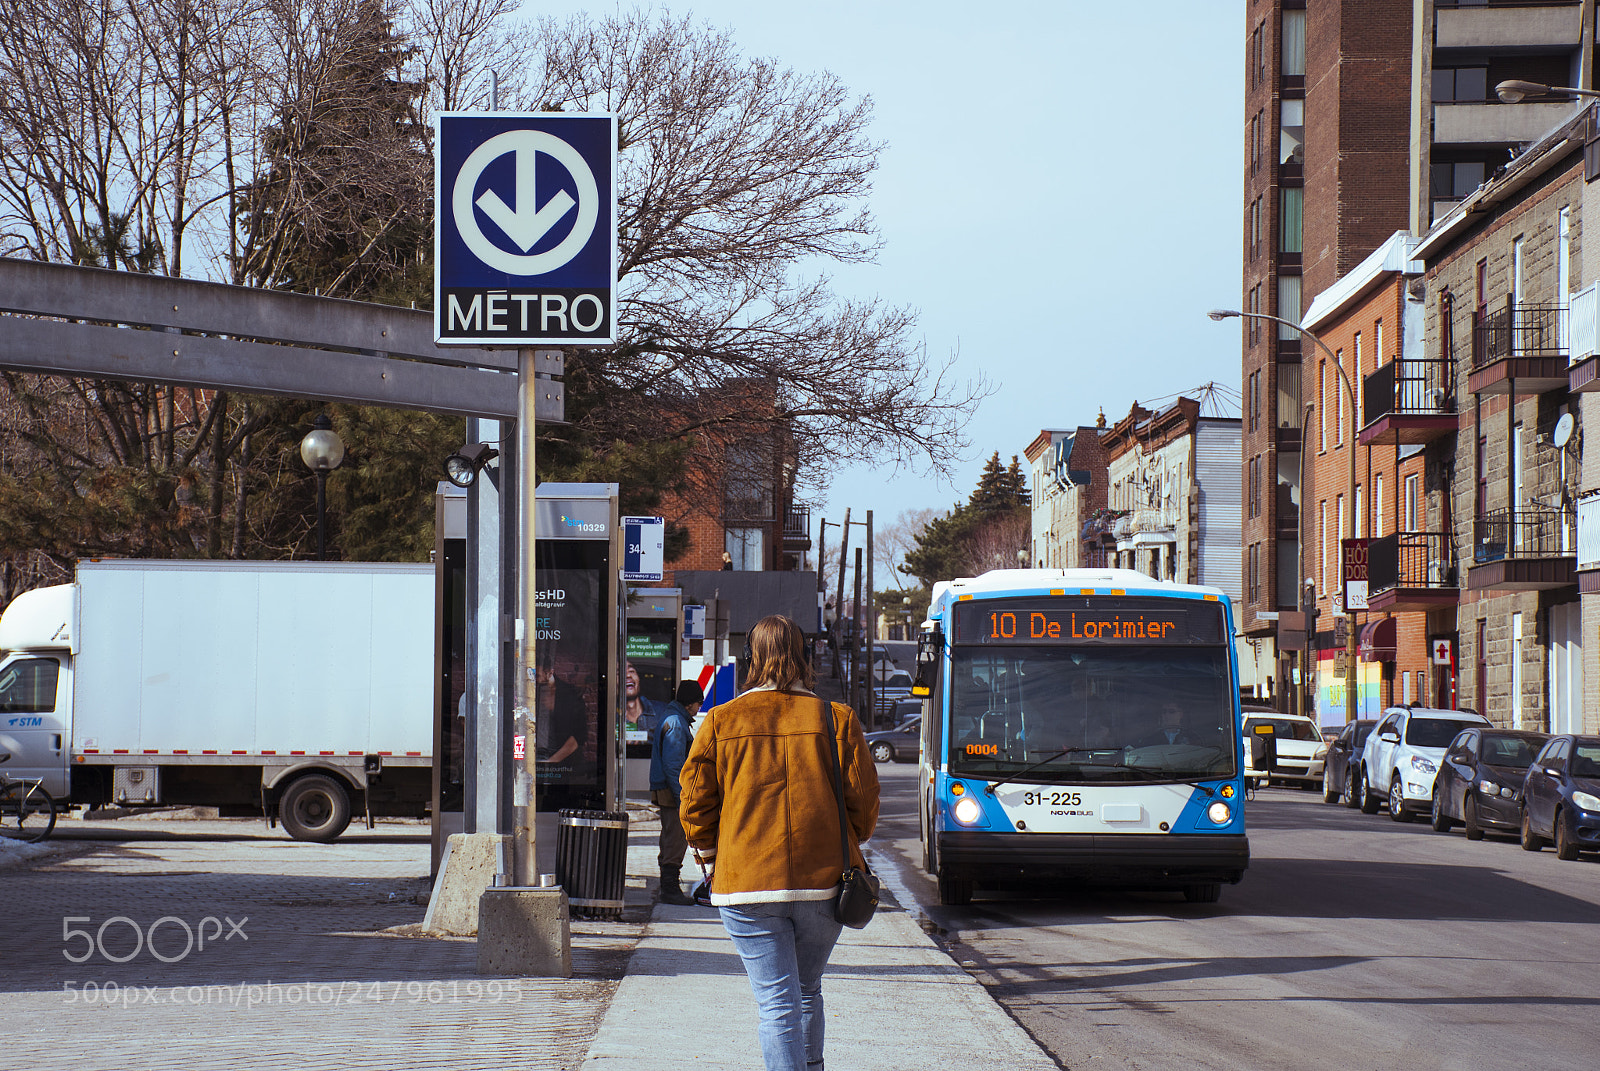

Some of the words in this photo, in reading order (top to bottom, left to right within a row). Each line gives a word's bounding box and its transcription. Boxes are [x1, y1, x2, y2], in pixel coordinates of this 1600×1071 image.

[448, 290, 604, 333] MÉTRO
[579, 524, 605, 532] 10329
[628, 544, 640, 554] 34
[991, 612, 1016, 638] 10
[1030, 612, 1061, 638] De
[1071, 612, 1175, 638] Lorimier
[19, 717, 42, 726] STM
[966, 744, 998, 755] 0004
[1024, 792, 1081, 806] 31-225
